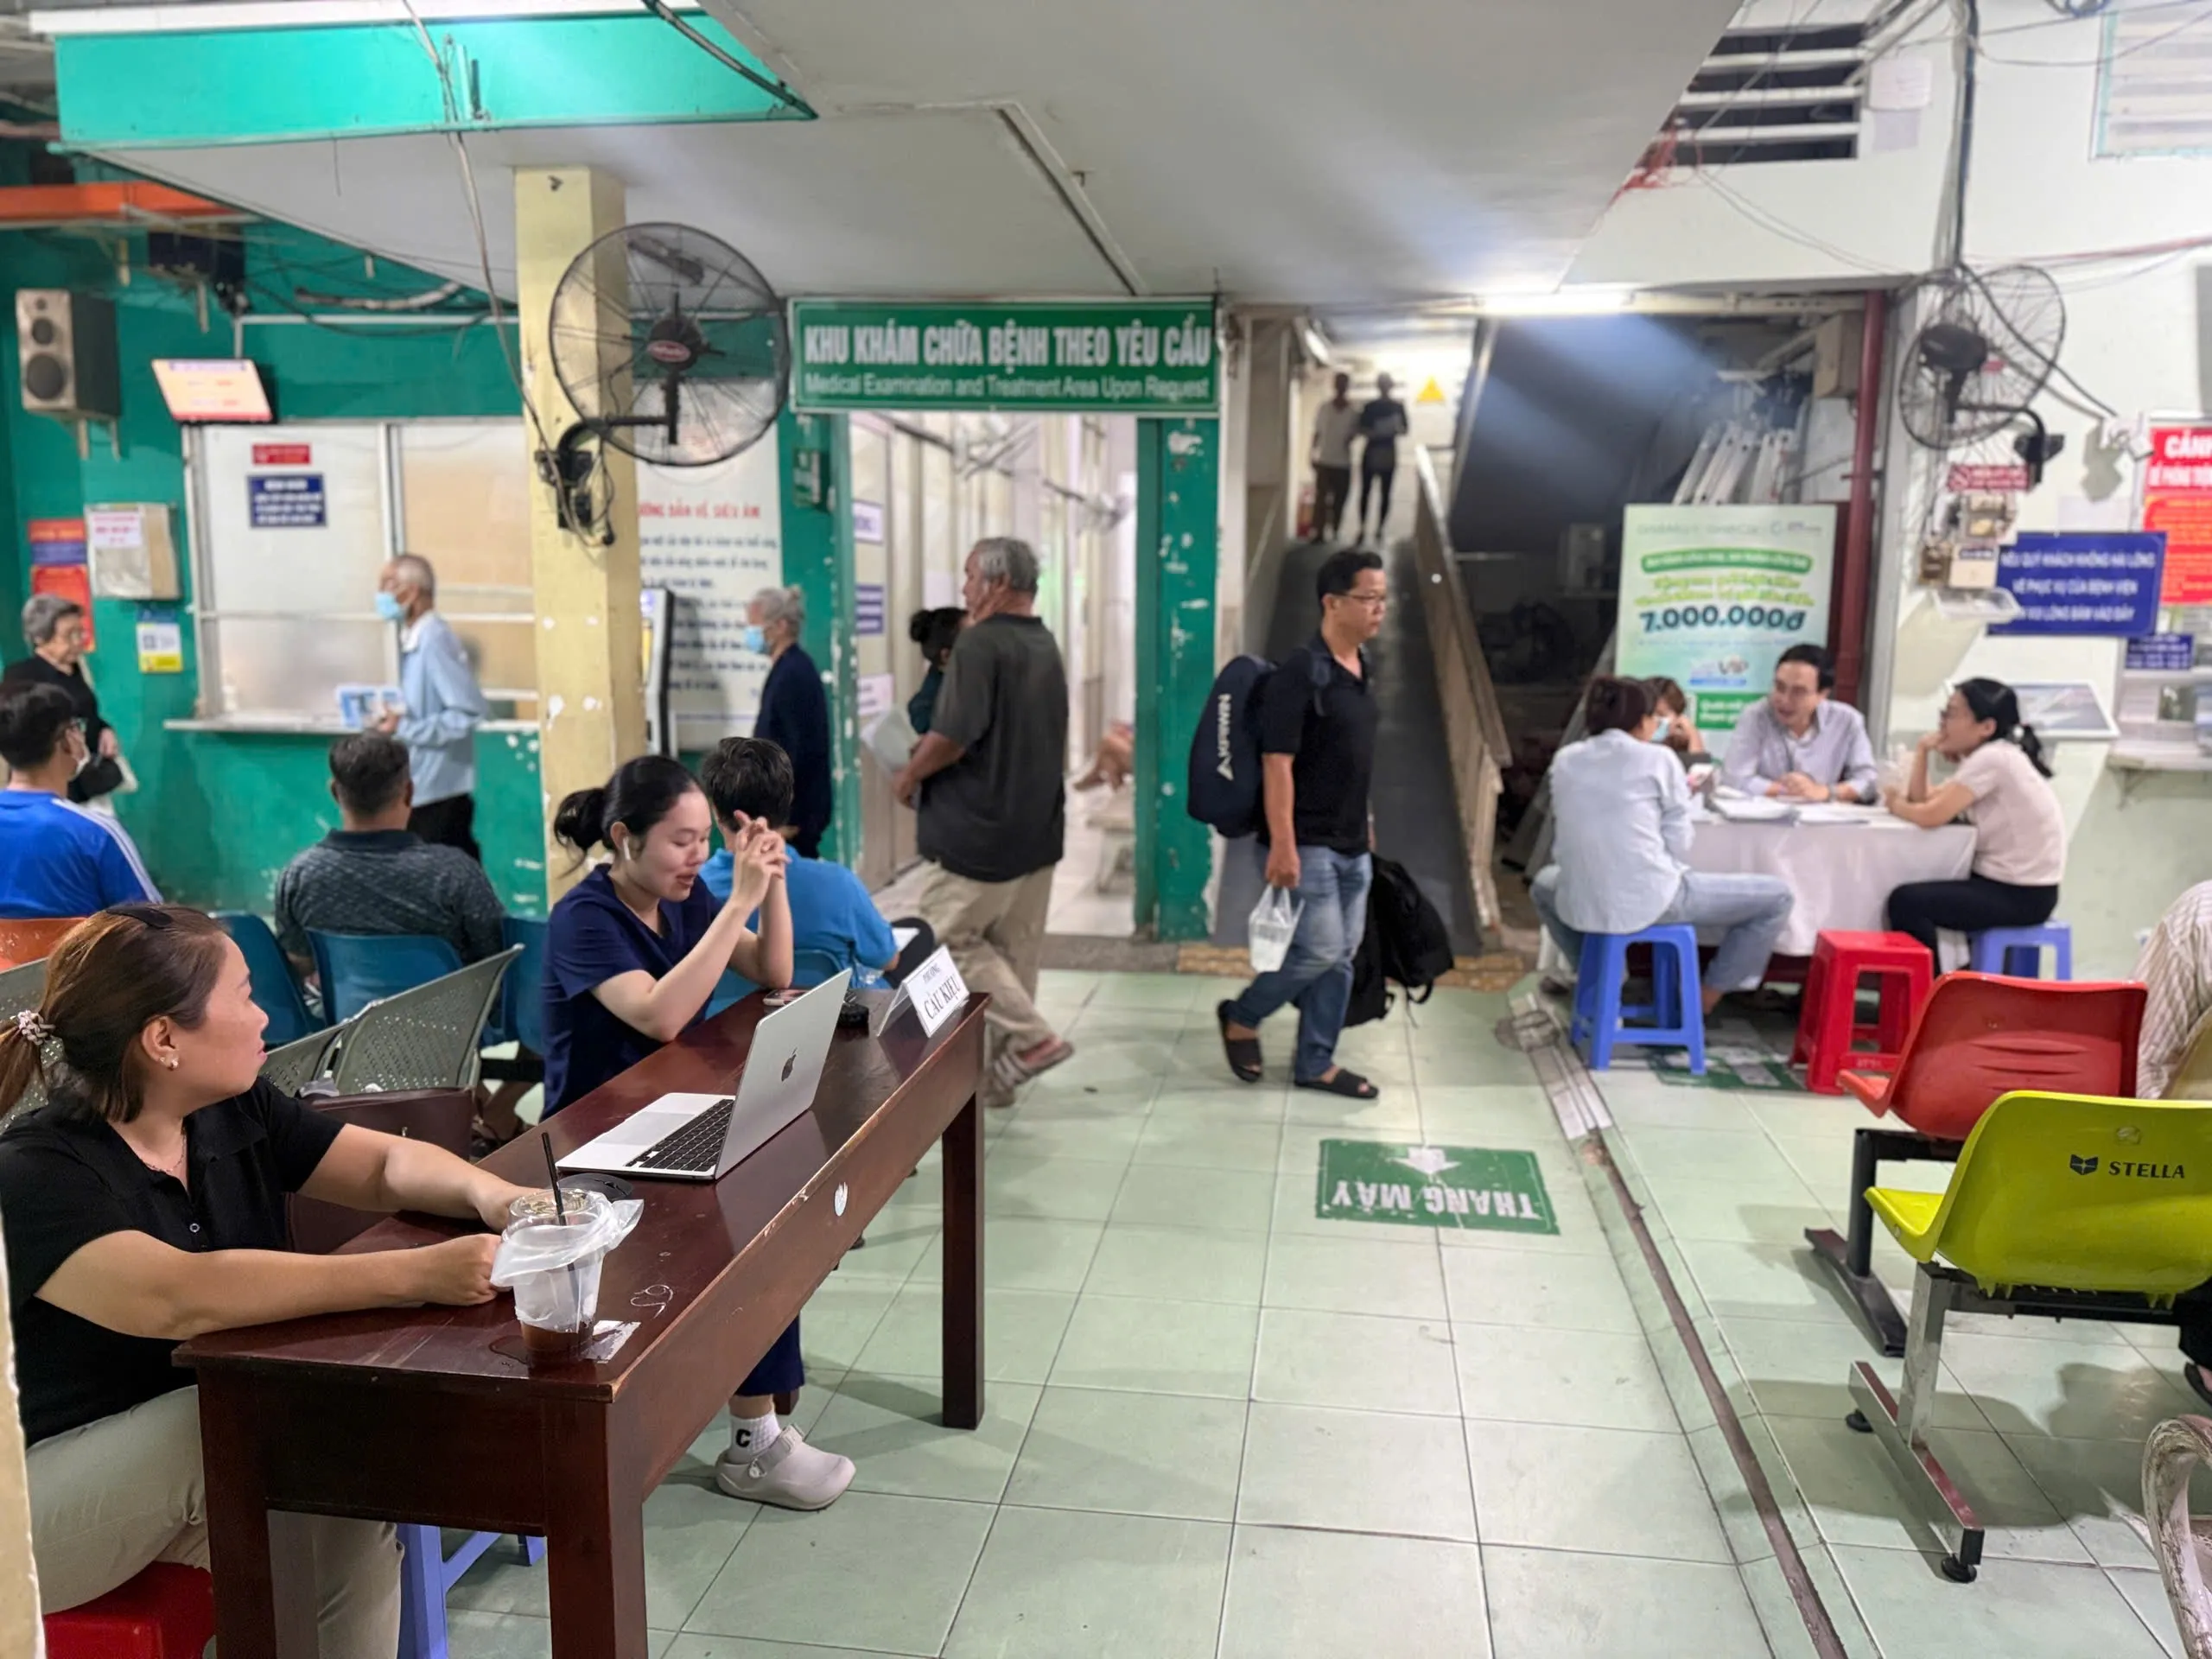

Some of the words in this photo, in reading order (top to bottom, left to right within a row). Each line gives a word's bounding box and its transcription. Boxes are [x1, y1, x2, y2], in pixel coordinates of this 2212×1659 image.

[804, 325, 849, 364] KHU
[853, 318, 918, 365] KHÁM
[924, 318, 983, 365] CHỮA
[988, 318, 1049, 374] BỆNH
[1053, 326, 1110, 366] THEO
[1115, 318, 1159, 366] YÊU
[804, 372, 861, 395] Medical
[864, 372, 952, 396] Examination
[955, 375, 984, 397] and
[987, 375, 1060, 397] Treatment
[1062, 375, 1099, 397] Area
[1101, 375, 1142, 401] Upon
[1145, 375, 1209, 401] Request
[1639, 605, 1806, 633] 7.000.000đ
[2108, 1160, 2185, 1179] STELLA
[1423, 1184, 1544, 1220] THANG
[735, 1428, 751, 1447] C
